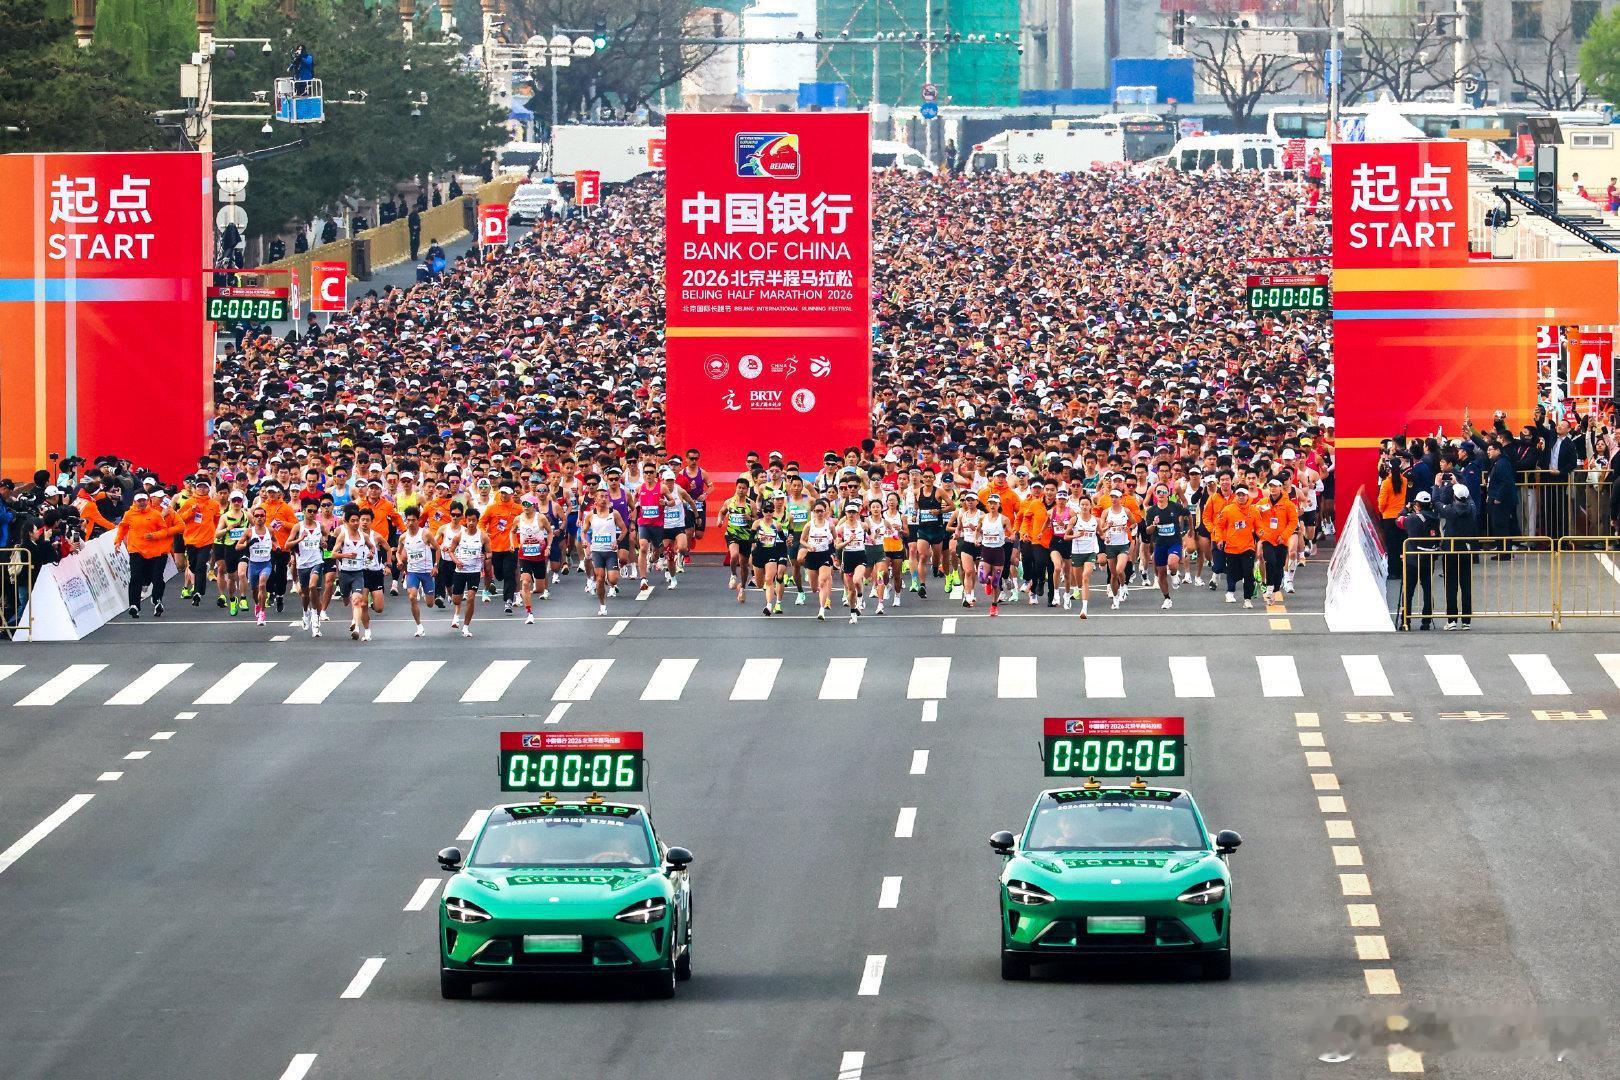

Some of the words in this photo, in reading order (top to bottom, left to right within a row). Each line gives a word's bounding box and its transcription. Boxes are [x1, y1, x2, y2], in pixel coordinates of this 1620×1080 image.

[653, 148, 664, 162] E
[1017, 152, 1044, 164] 公安
[770, 162, 796, 170] BEIJING
[582, 180, 596, 199] E
[1350, 162, 1454, 213] 起点
[49, 174, 153, 225] 起点
[681, 190, 854, 235] 中国银行
[485, 217, 502, 237] D
[1349, 221, 1456, 249] START
[48, 233, 155, 260] START
[683, 241, 743, 260] BANK
[748, 241, 779, 260] OF
[783, 241, 852, 260] CHINA
[682, 269, 853, 287] 2026北京半程马拉松
[320, 277, 339, 302] C
[682, 289, 723, 300] BEIJING
[727, 289, 755, 300] HALF
[760, 289, 823, 300] MARATHON
[827, 289, 853, 300] 2026
[1251, 287, 1324, 308] 0:00:06
[210, 299, 283, 319] 0:00:06
[1574, 353, 1607, 385] A
[750, 390, 783, 401] BRTV
[1052, 740, 1176, 772] 0:00:06
[508, 754, 635, 787] 0:00:06
